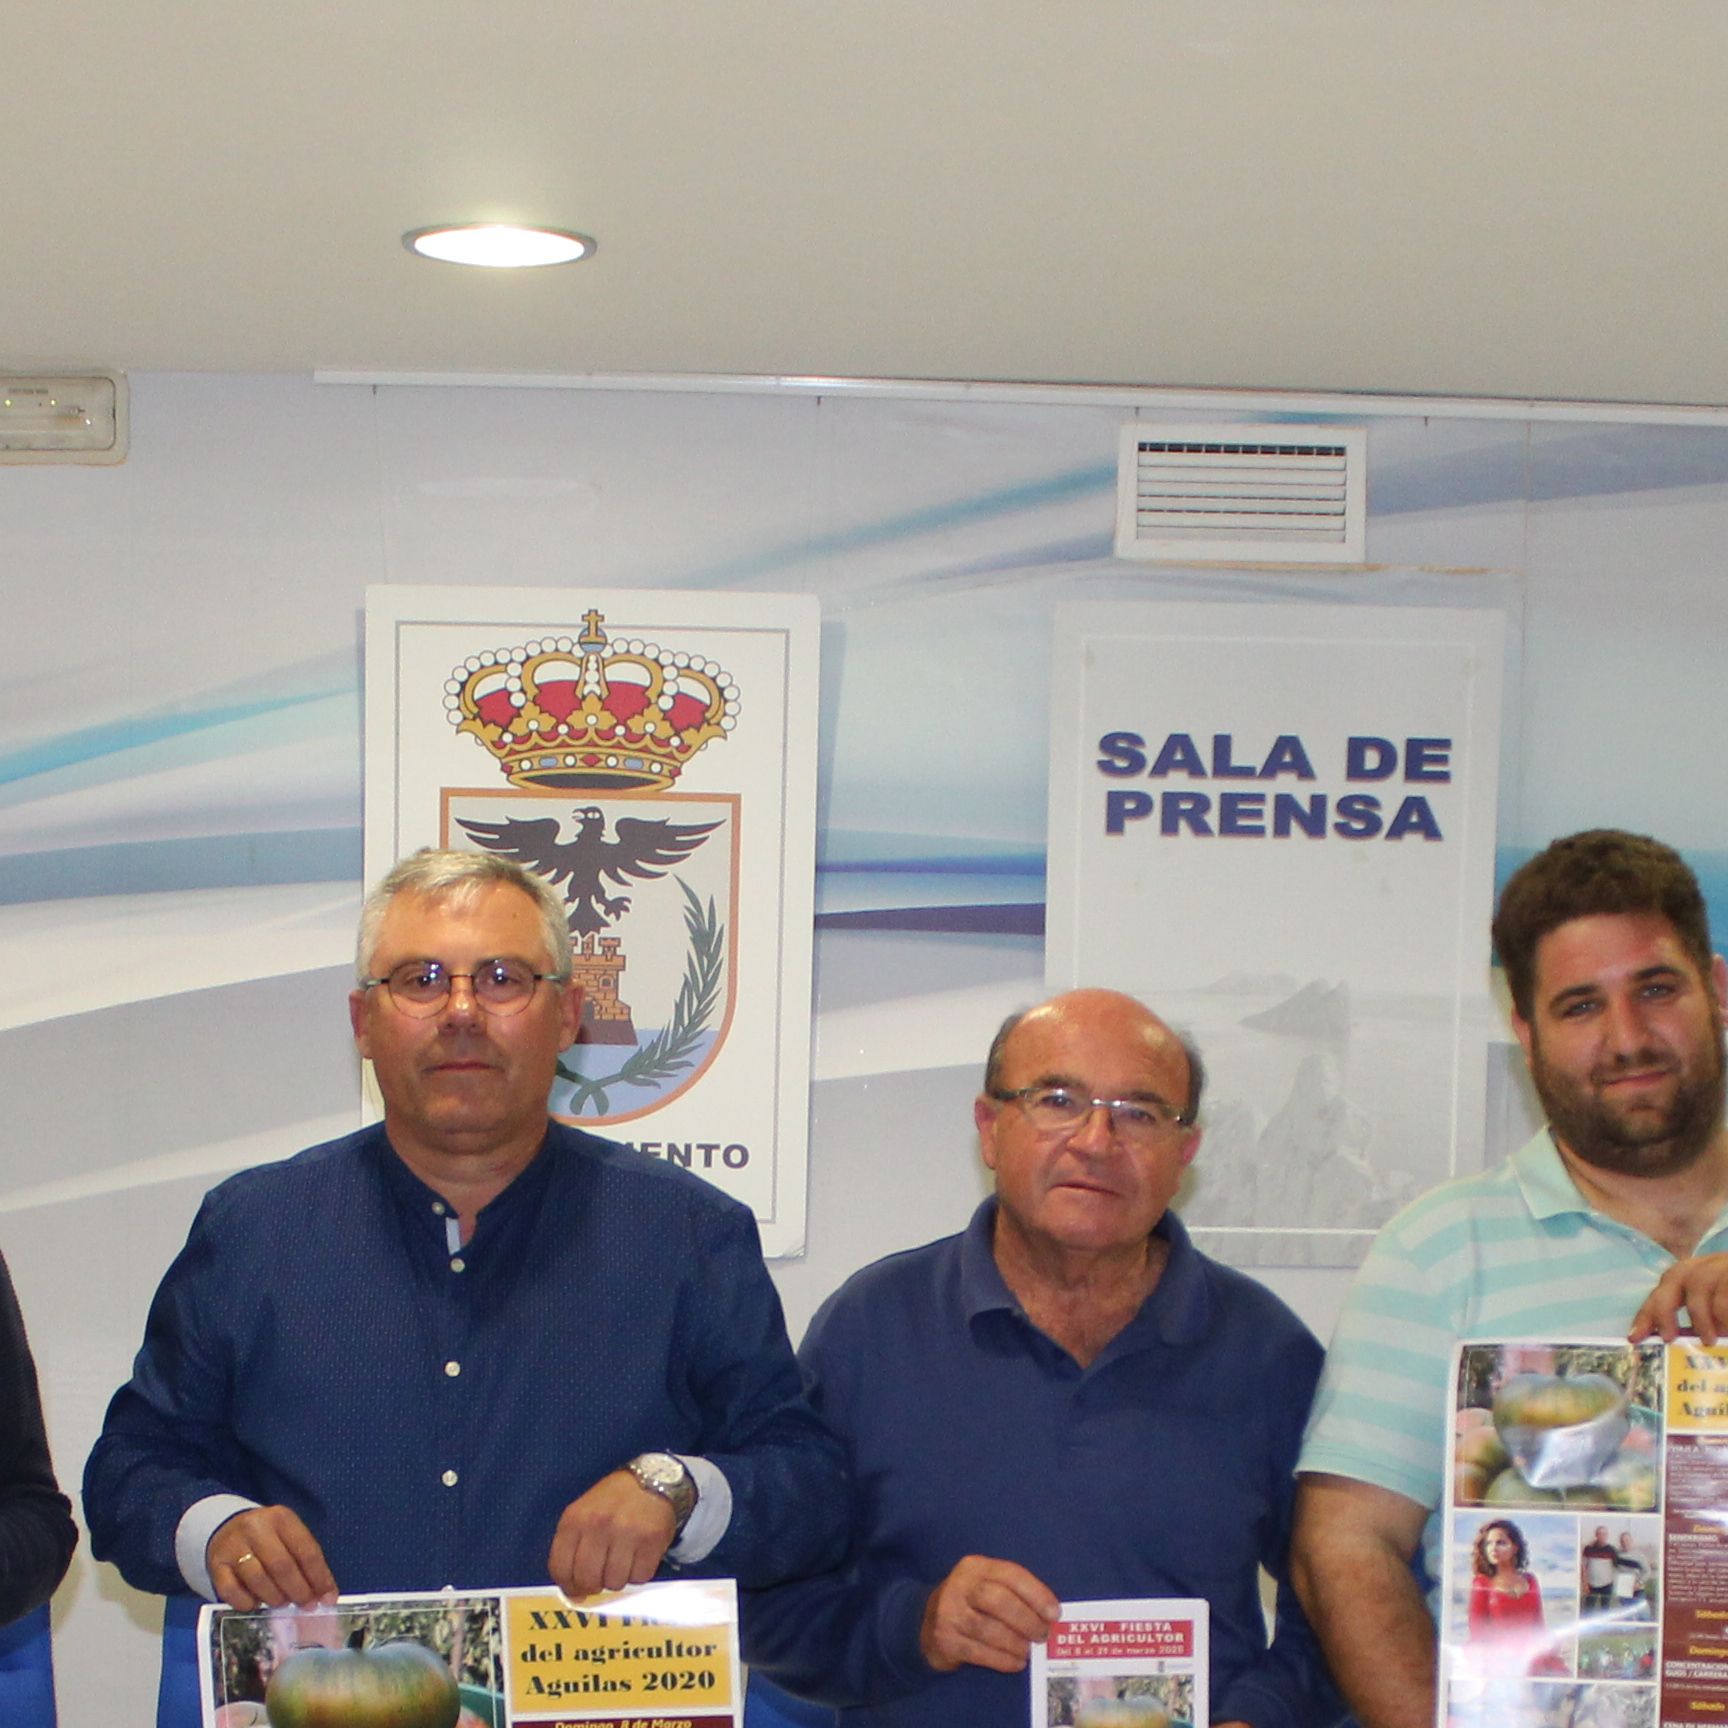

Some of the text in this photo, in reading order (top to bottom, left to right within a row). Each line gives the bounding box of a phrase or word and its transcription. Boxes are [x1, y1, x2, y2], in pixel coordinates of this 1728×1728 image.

[1097, 731, 1452, 783] SALA DE
[1105, 790, 1443, 841] PRENSA
[1057, 1633, 1184, 1644] DEL AGRICULTOR
[1070, 1622, 1172, 1632] XXVI FIESTA
[521, 1640, 717, 1664] del agricultor
[526, 1670, 715, 1698] Aguilas 2020
